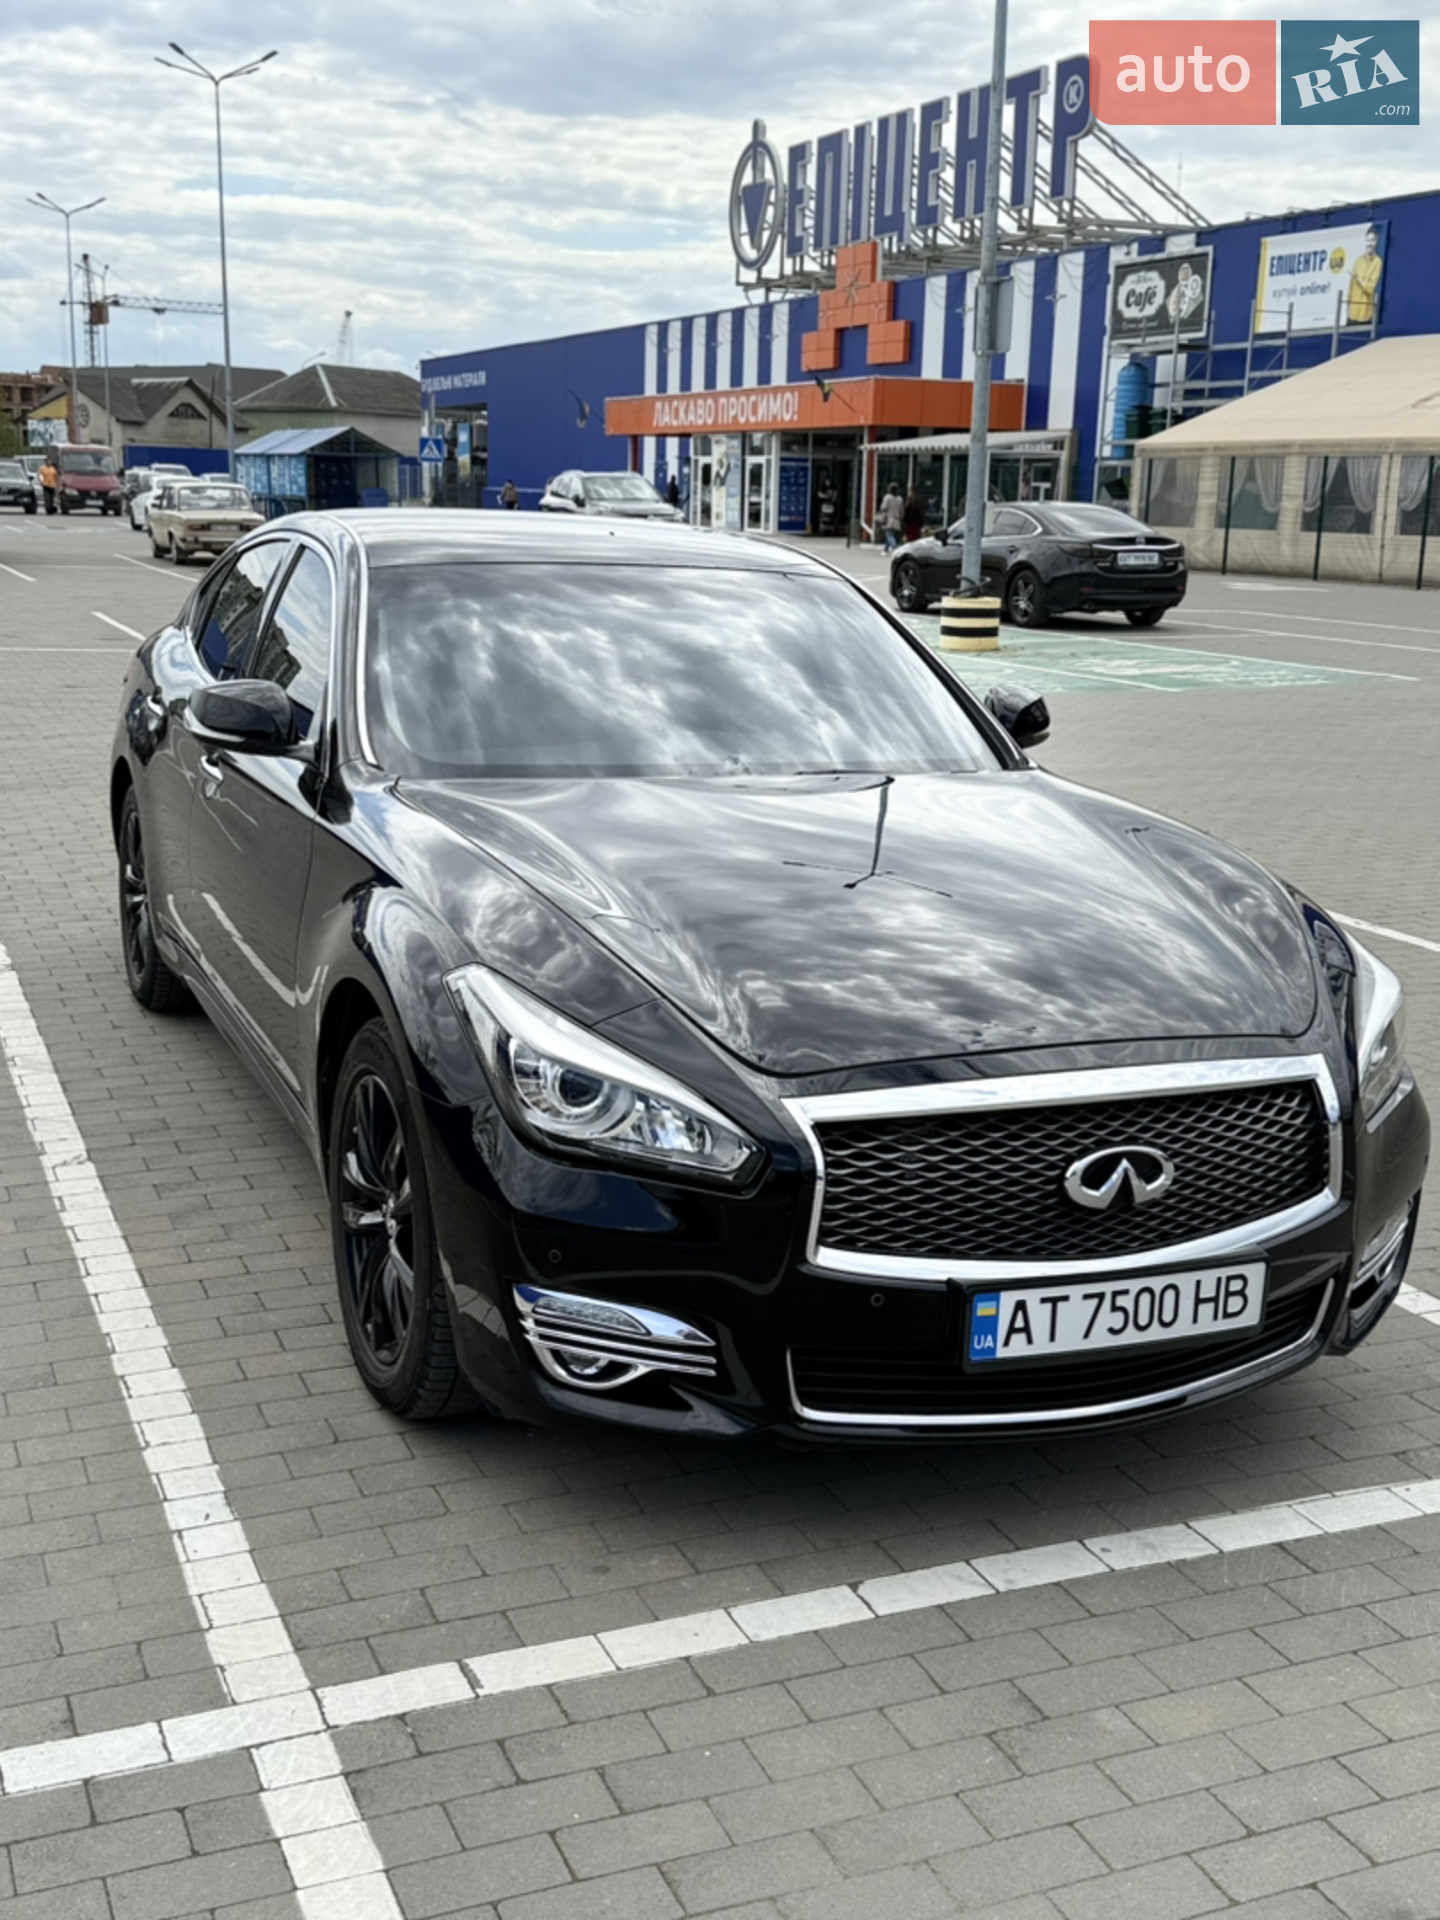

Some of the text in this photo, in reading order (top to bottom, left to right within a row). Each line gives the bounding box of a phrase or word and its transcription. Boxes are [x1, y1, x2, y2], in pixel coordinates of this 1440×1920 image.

[786, 54, 1096, 259] ЕПІЦЕНТР
[1269, 249, 1328, 277] ЕПІЦЕНТР
[652, 391, 799, 427] ЛАСКАВО ПРОСИМО!
[1002, 1273, 1249, 1348] AT 7500 HB
[974, 1334, 994, 1349] UA
